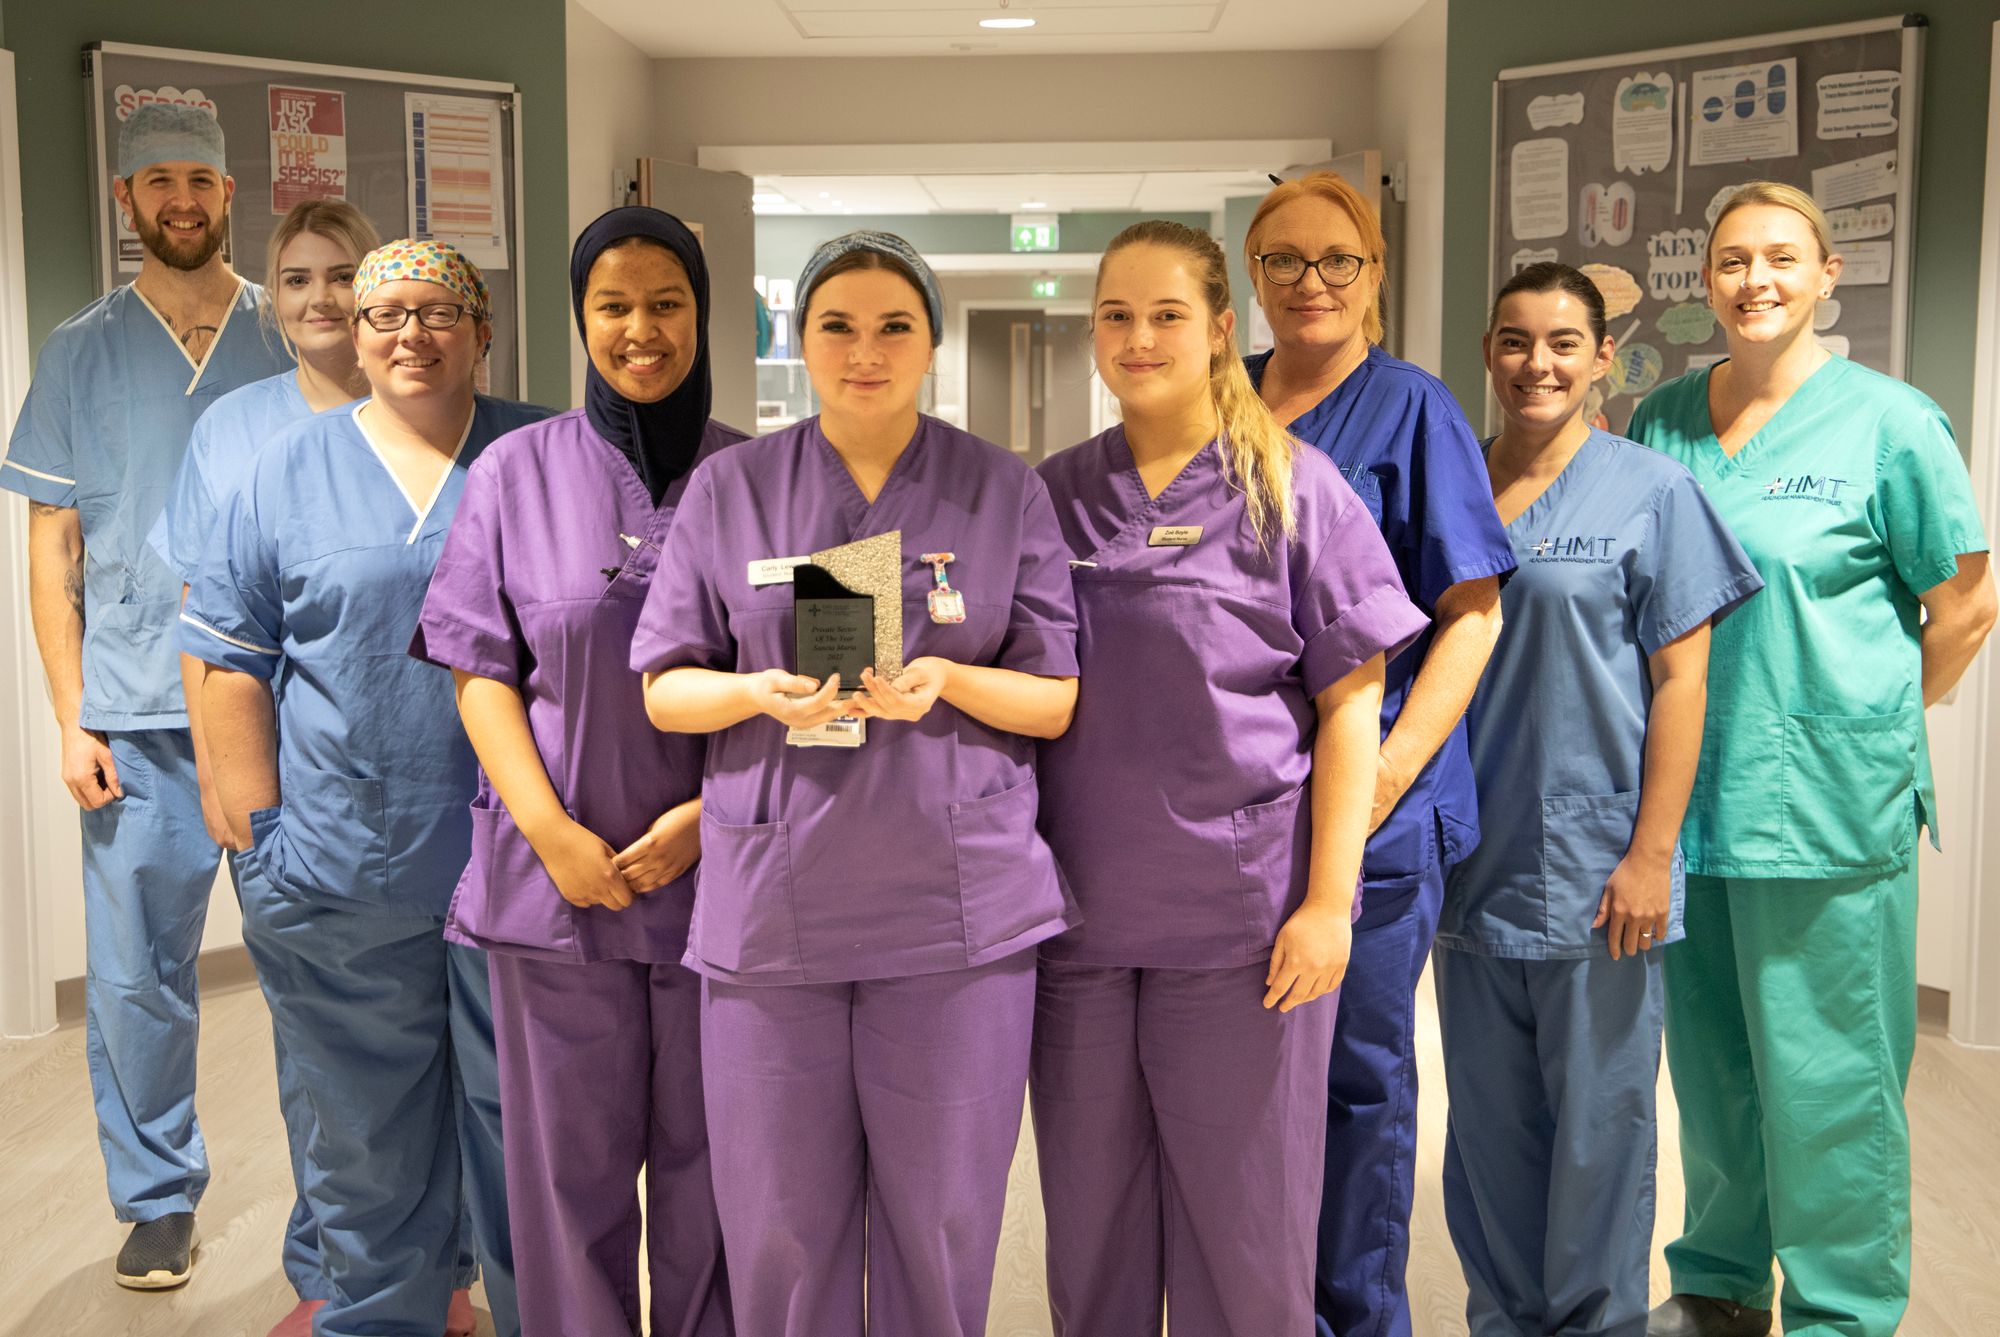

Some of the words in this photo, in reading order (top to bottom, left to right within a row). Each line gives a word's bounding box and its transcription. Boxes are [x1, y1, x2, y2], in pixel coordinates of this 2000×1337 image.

[276, 99, 316, 118] JUST
[277, 115, 311, 135] ASK
[279, 150, 292, 167] IT
[295, 151, 316, 168] BE
[1654, 237, 1698, 257] KEY
[1651, 271, 1705, 290] TOP
[1625, 350, 1644, 384] TURP
[1784, 475, 1847, 498] HMT
[1790, 494, 1825, 503] MANAGEMENT
[1826, 498, 1842, 506] TRUST
[1552, 536, 1616, 557] HMT
[812, 625, 835, 633] Private
[836, 625, 858, 633] Sector
[815, 635, 825, 643] Of
